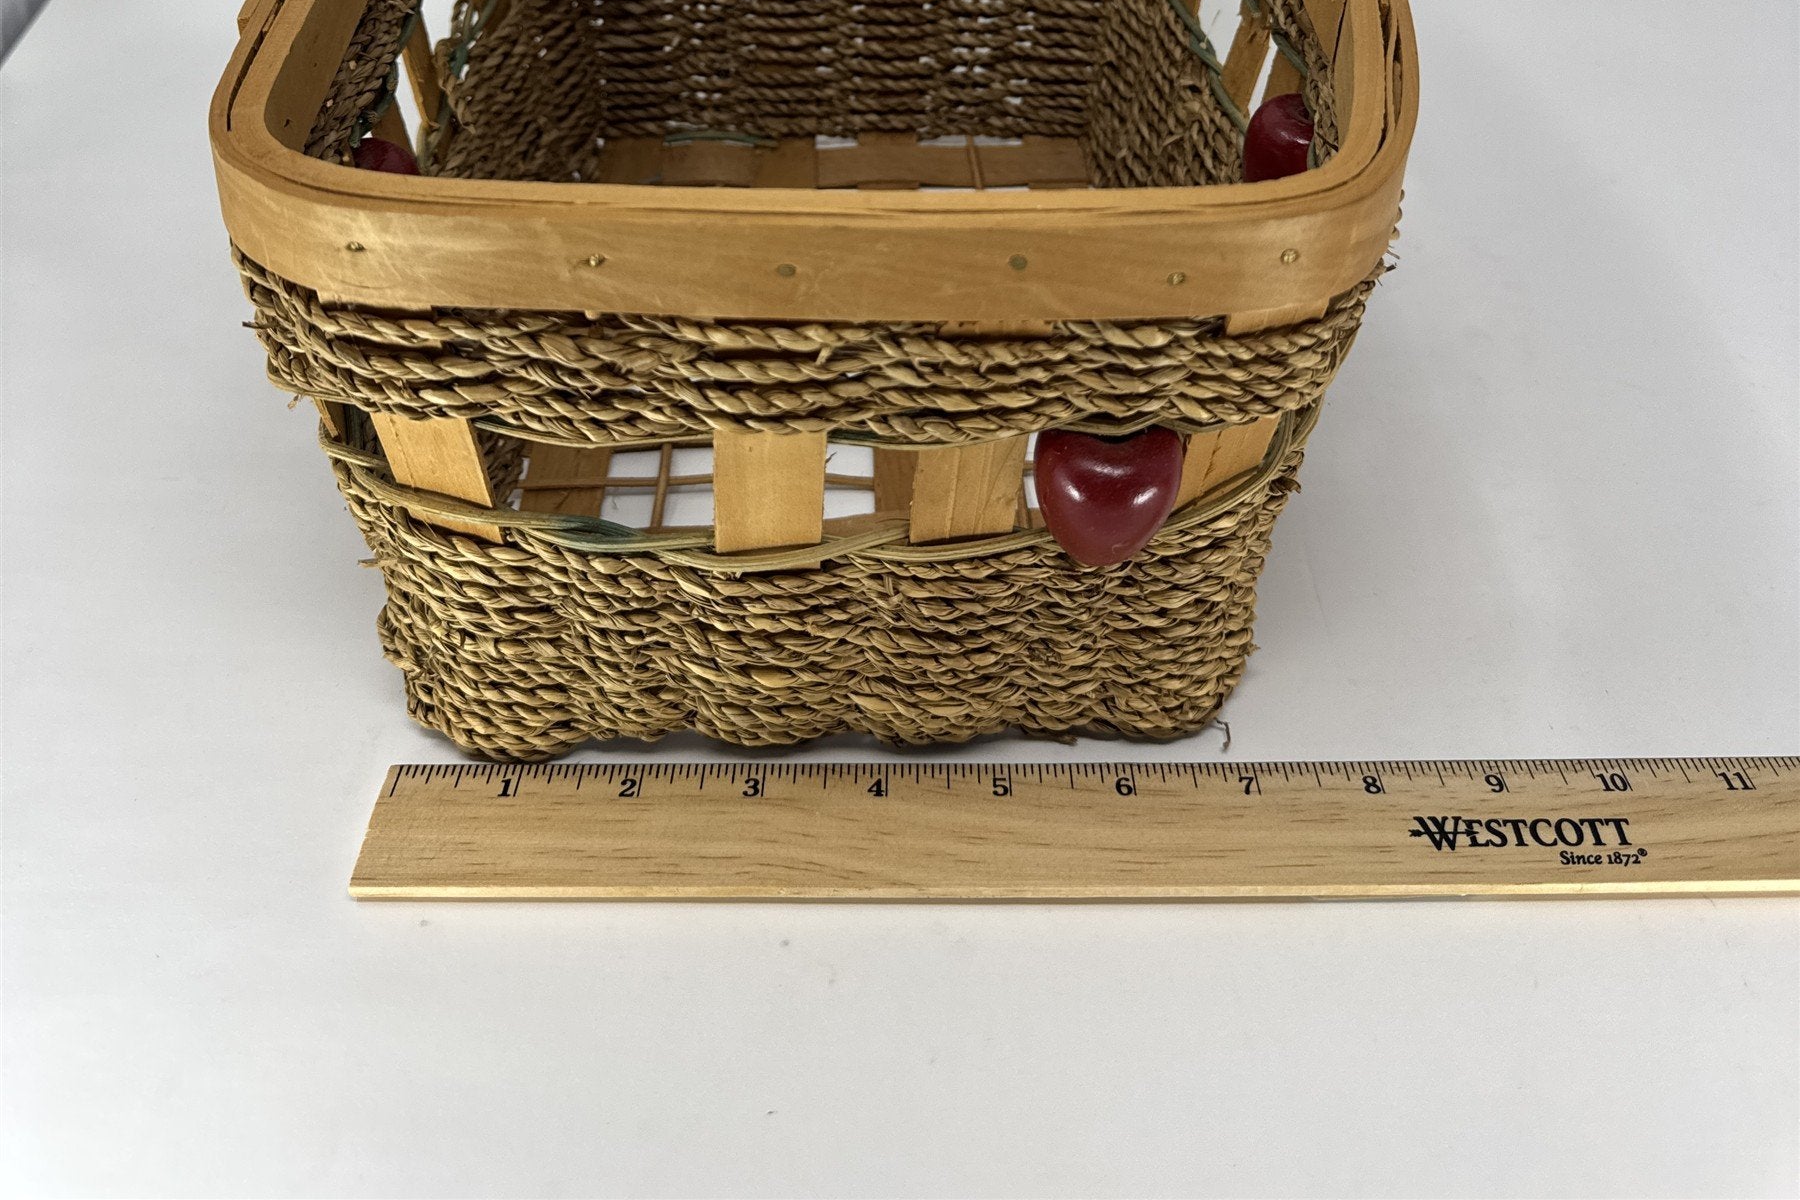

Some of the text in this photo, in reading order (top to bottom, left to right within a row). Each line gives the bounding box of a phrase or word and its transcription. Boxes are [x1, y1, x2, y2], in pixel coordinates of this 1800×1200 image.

[496, 771, 1754, 798] 1 2 3 4 5 6 7 8 9 10 11
[1411, 815, 1633, 852] WESTCOTT
[1559, 850, 1603, 866] Since
